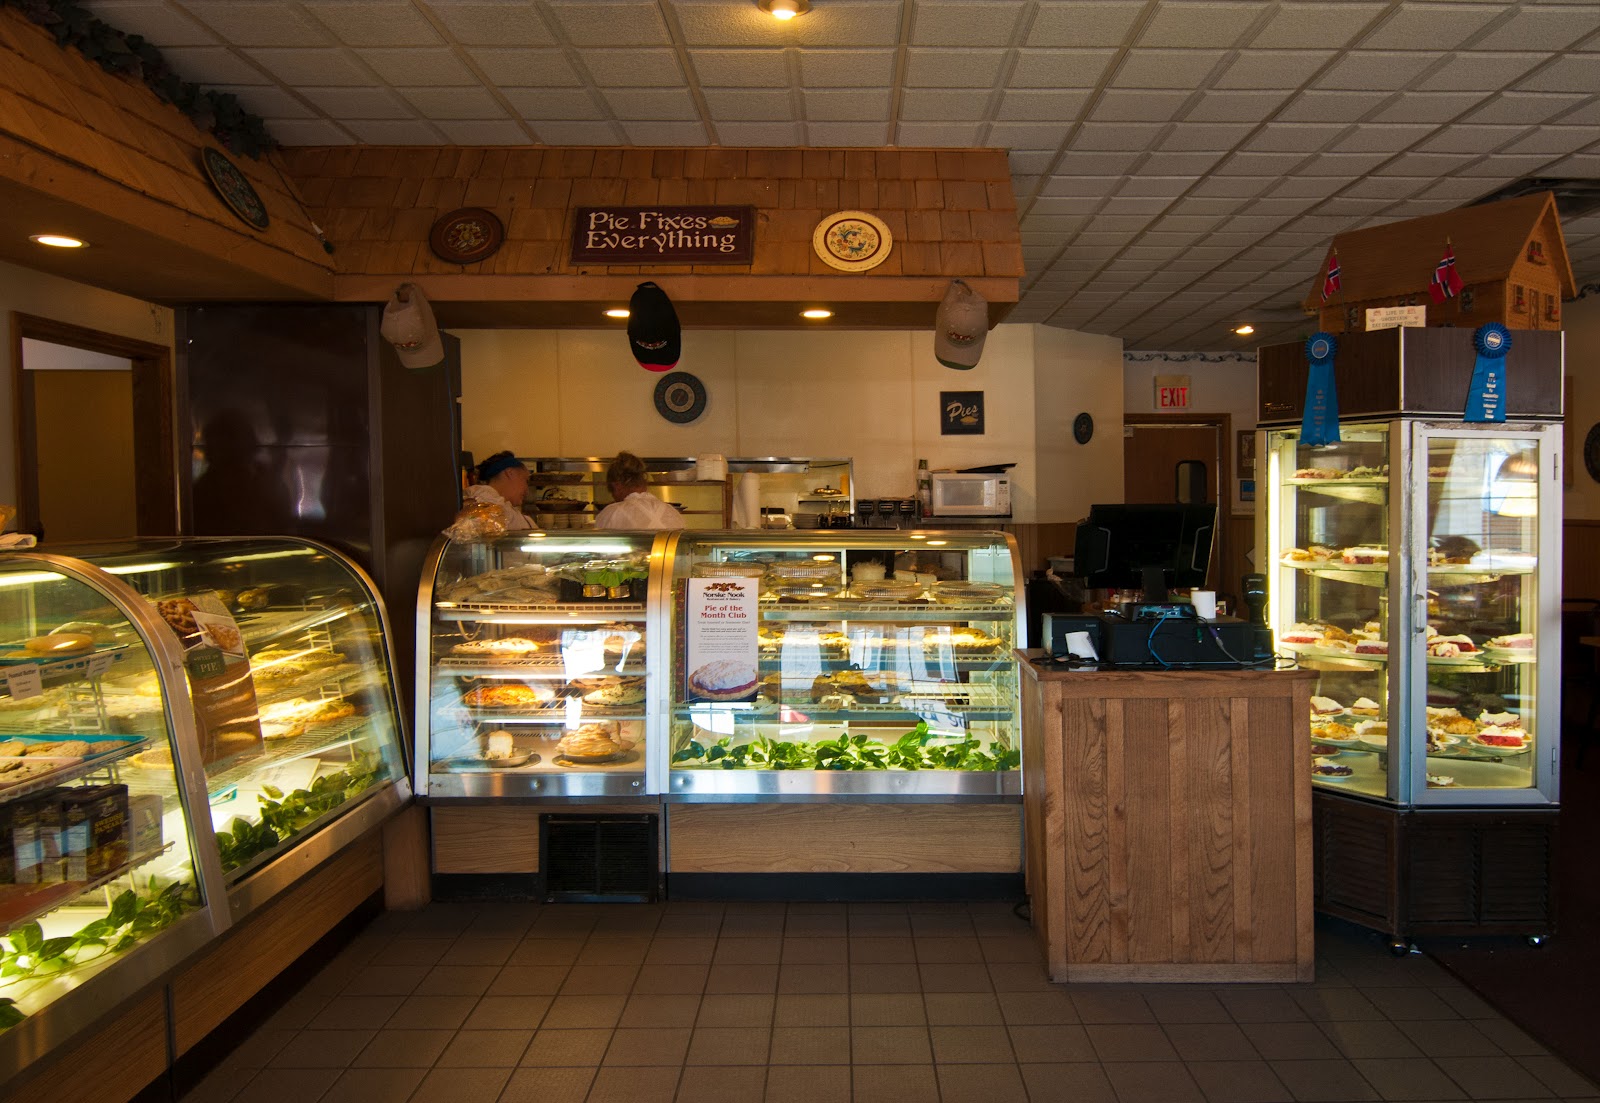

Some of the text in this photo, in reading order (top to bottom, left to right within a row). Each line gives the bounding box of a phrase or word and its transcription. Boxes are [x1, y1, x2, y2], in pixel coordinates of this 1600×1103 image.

[589, 212, 707, 231] Pie Fixes
[586, 230, 736, 253] Everything
[1161, 387, 1188, 407] EXIT
[946, 402, 979, 422] Pies
[200, 662, 218, 673] PIE
